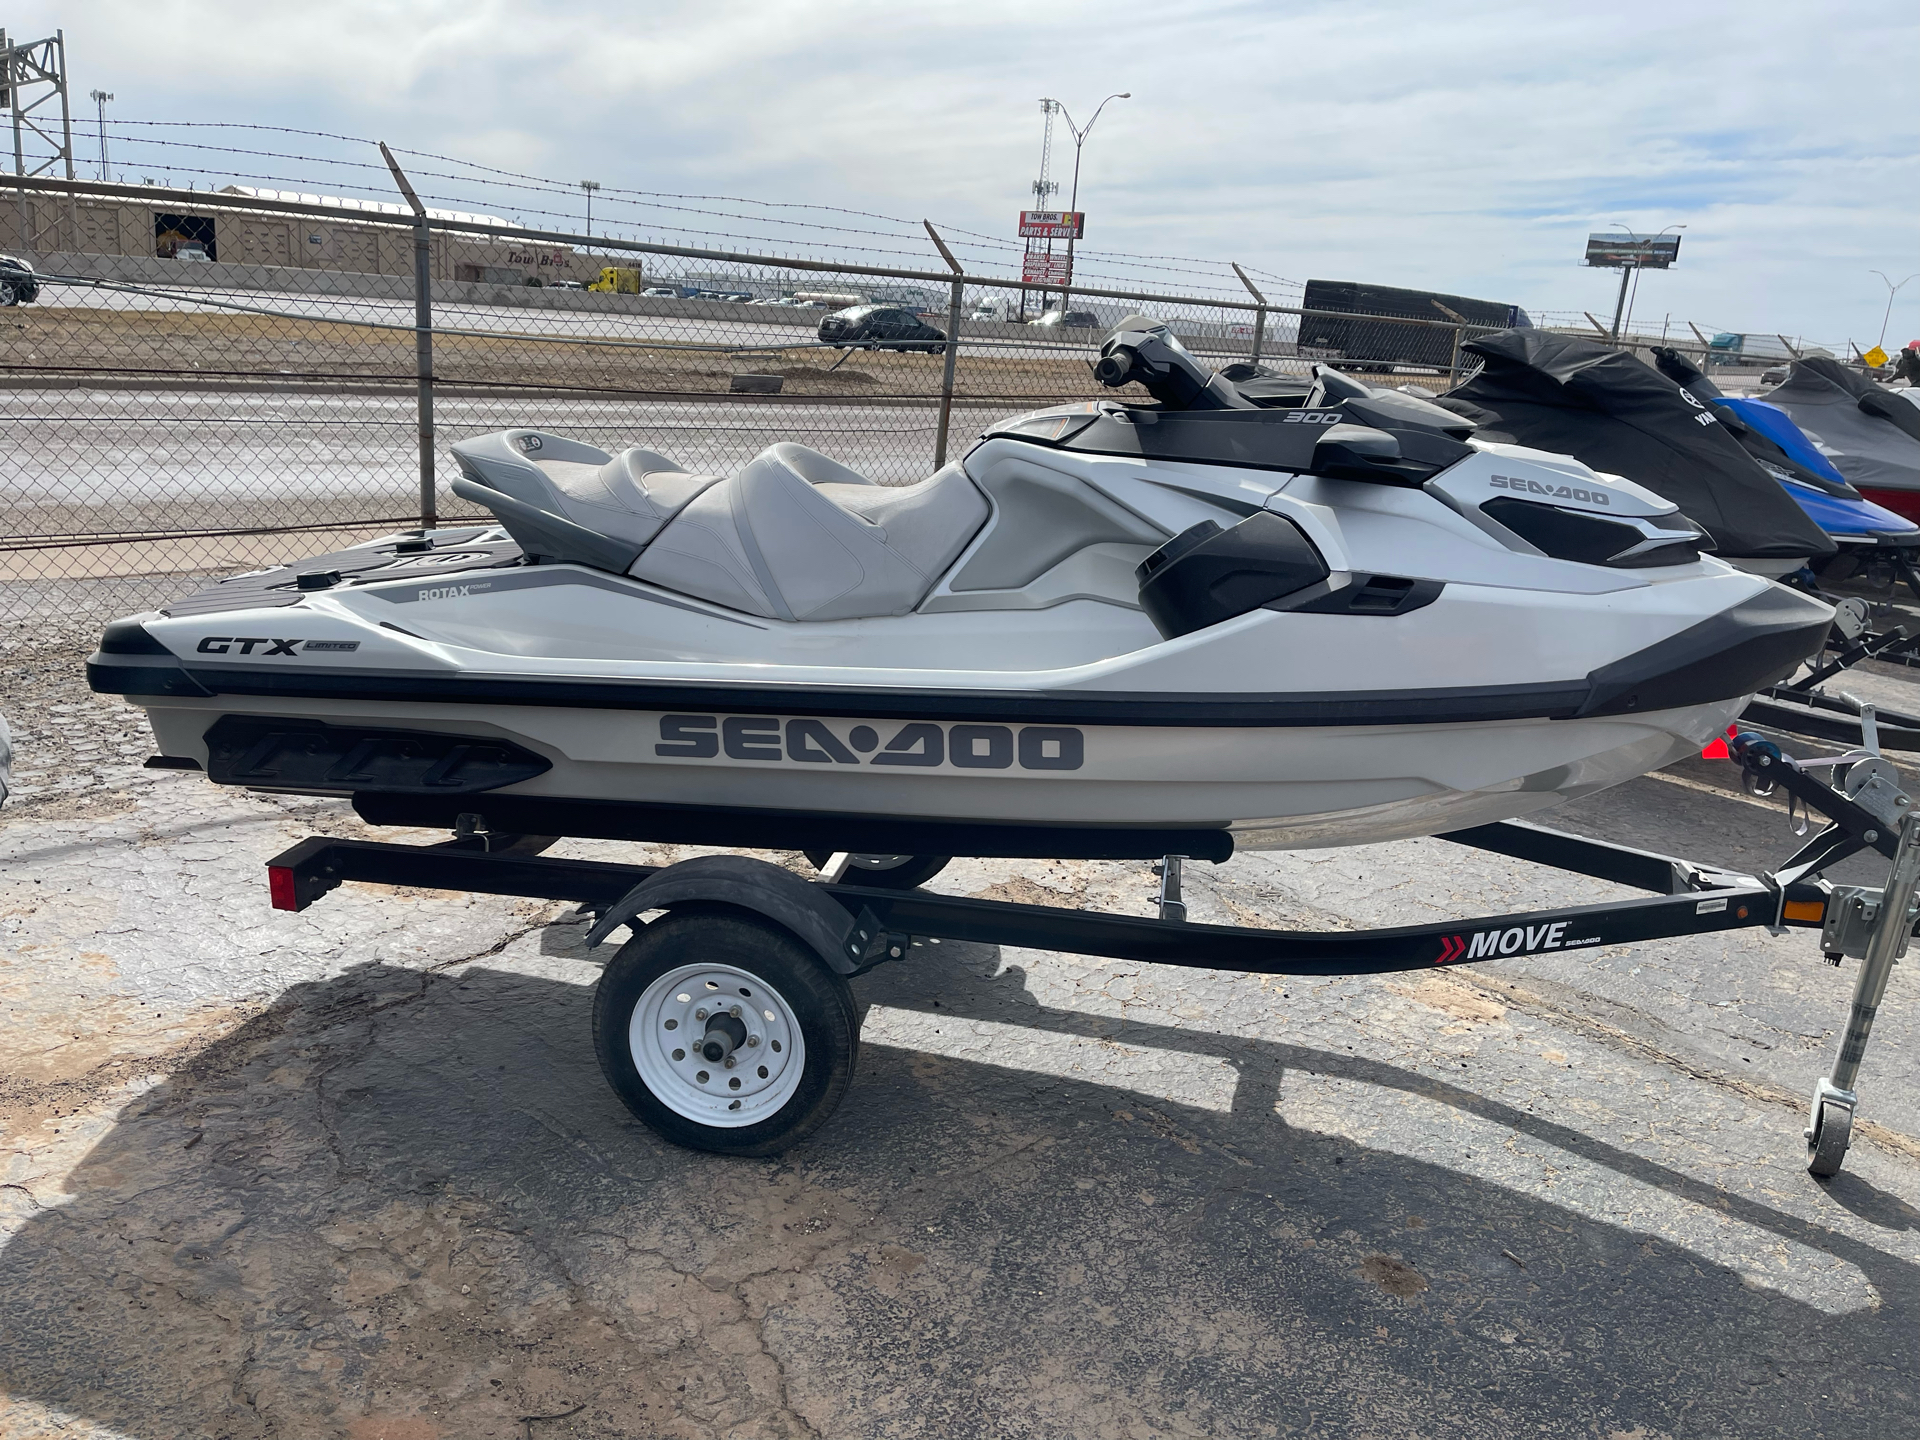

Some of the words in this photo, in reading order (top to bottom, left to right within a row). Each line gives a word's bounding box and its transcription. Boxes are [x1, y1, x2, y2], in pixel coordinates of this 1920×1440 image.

[1020, 226, 1042, 236] PARTS
[1042, 227, 1048, 236] &
[1282, 411, 1343, 425] 300
[418, 585, 471, 601] ROTAX
[469, 582, 492, 590] POWER
[196, 636, 305, 657] GTX
[305, 640, 358, 650] LIMITED
[1466, 921, 1568, 959] MOVE
